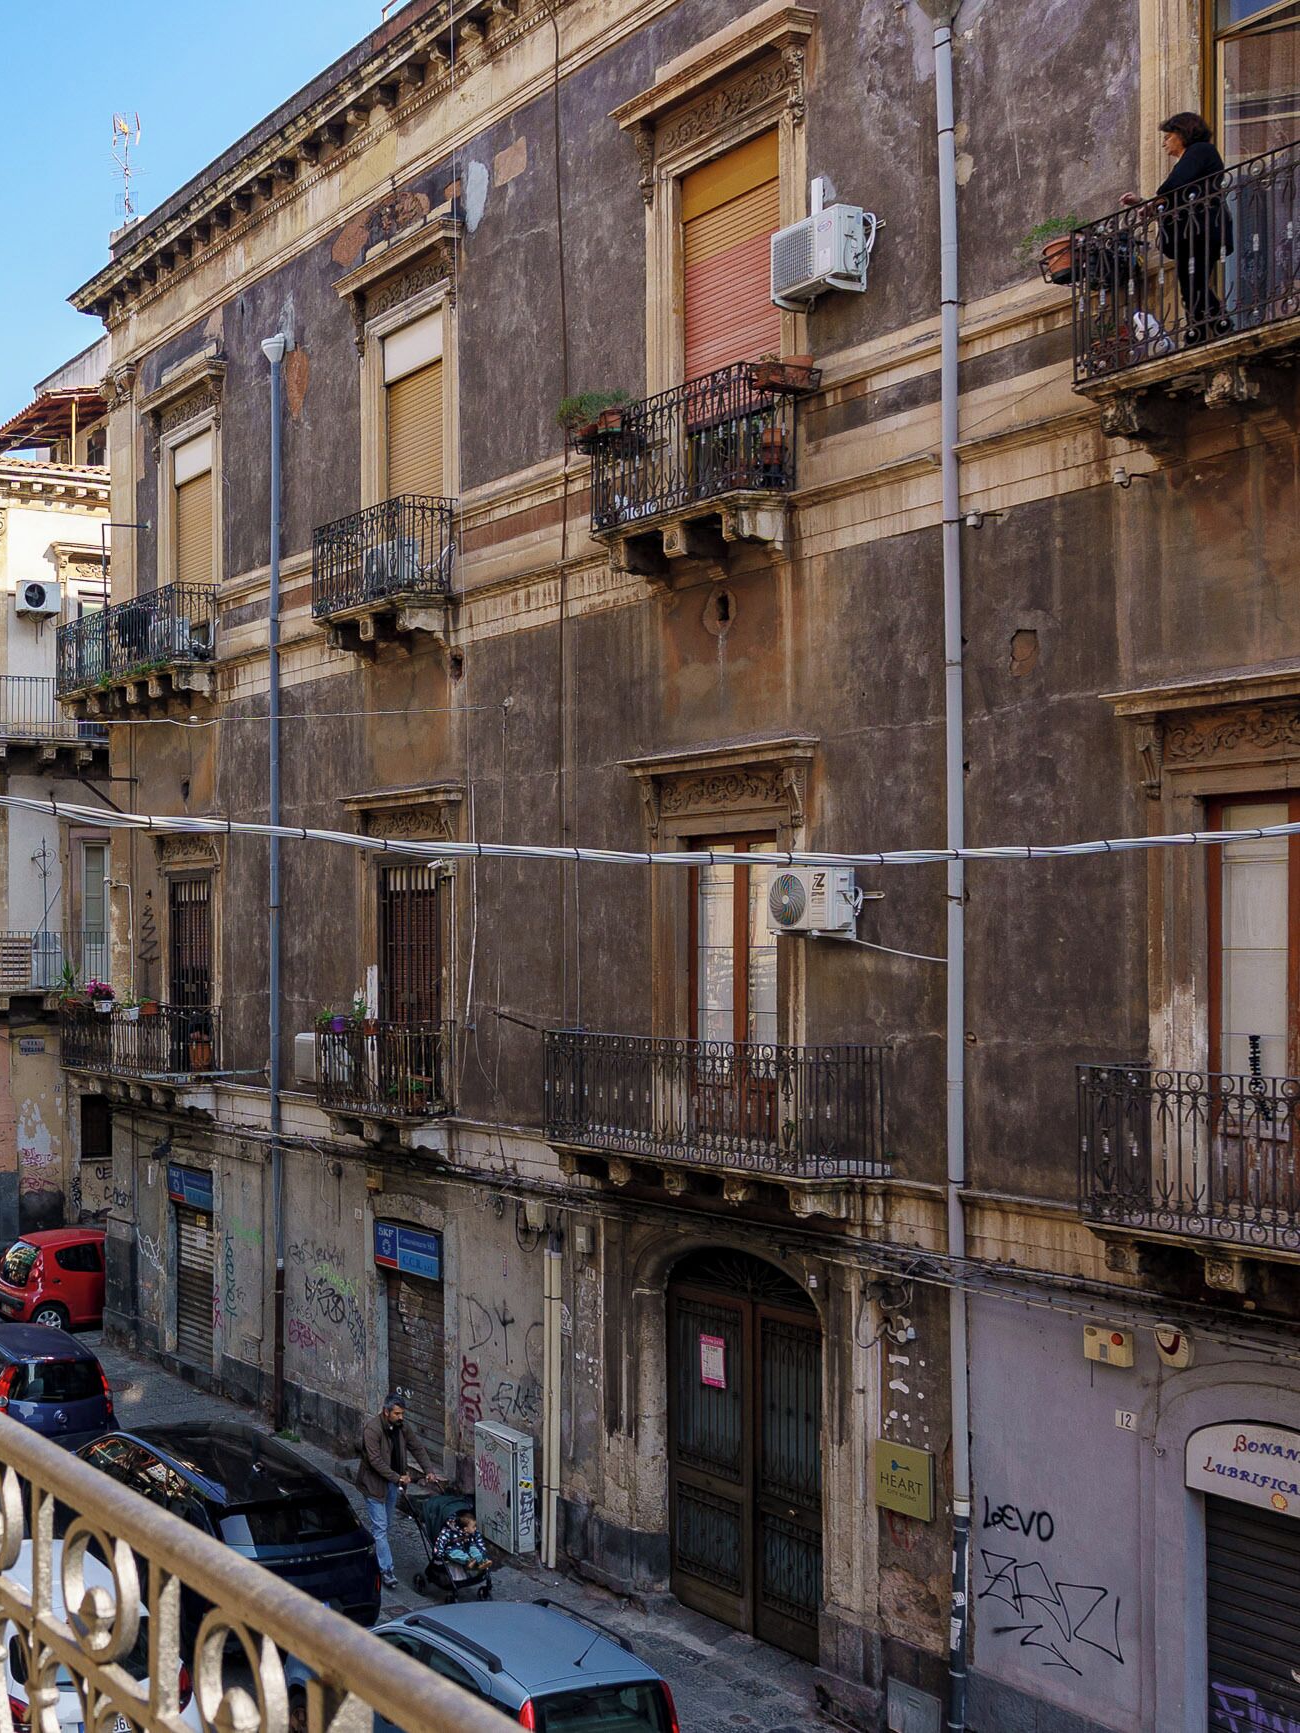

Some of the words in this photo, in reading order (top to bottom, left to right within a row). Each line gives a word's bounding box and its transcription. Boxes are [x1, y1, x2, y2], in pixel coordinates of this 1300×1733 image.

[378, 1227, 395, 1238] SKF
[1121, 1412, 1132, 1428] 12
[1233, 1434, 1300, 1463] BONAN
[881, 1472, 923, 1495] HEART
